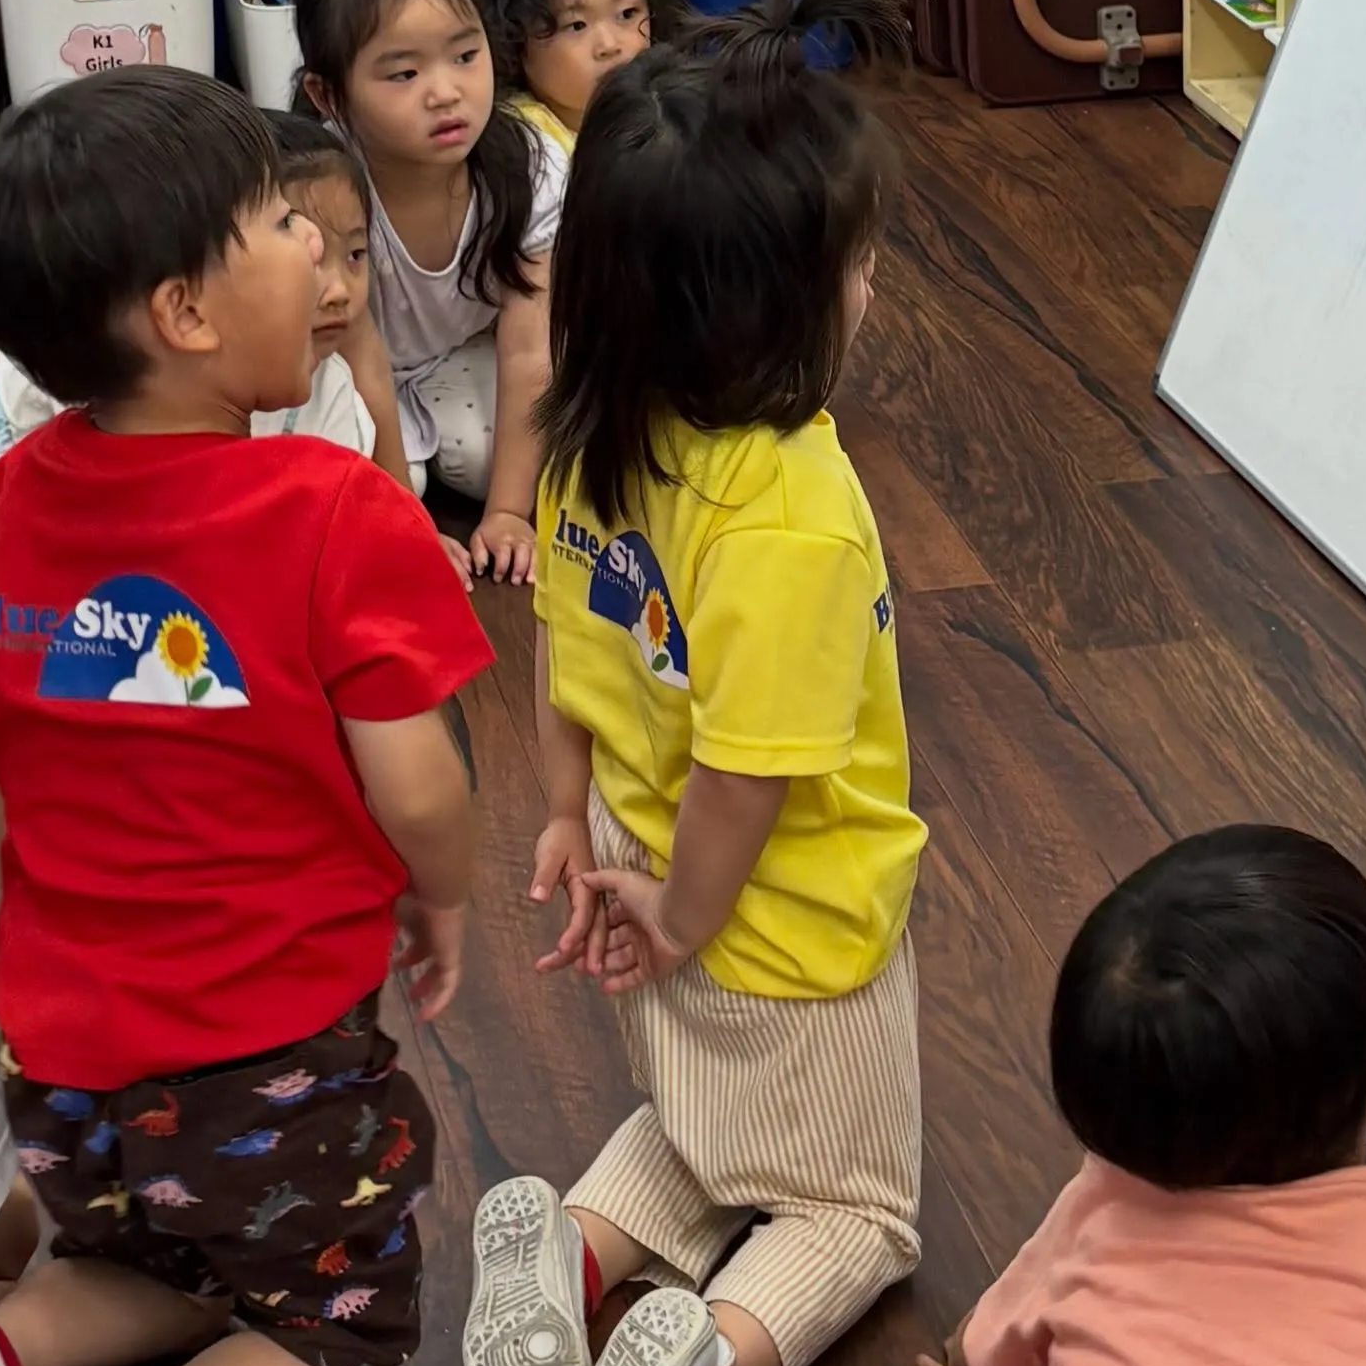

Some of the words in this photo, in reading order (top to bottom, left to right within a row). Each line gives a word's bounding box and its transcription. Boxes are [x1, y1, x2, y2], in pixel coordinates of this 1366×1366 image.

[93, 35, 114, 49] K1
[85, 56, 124, 73] Girls
[555, 508, 600, 561] lue
[73, 597, 151, 651] Sky
